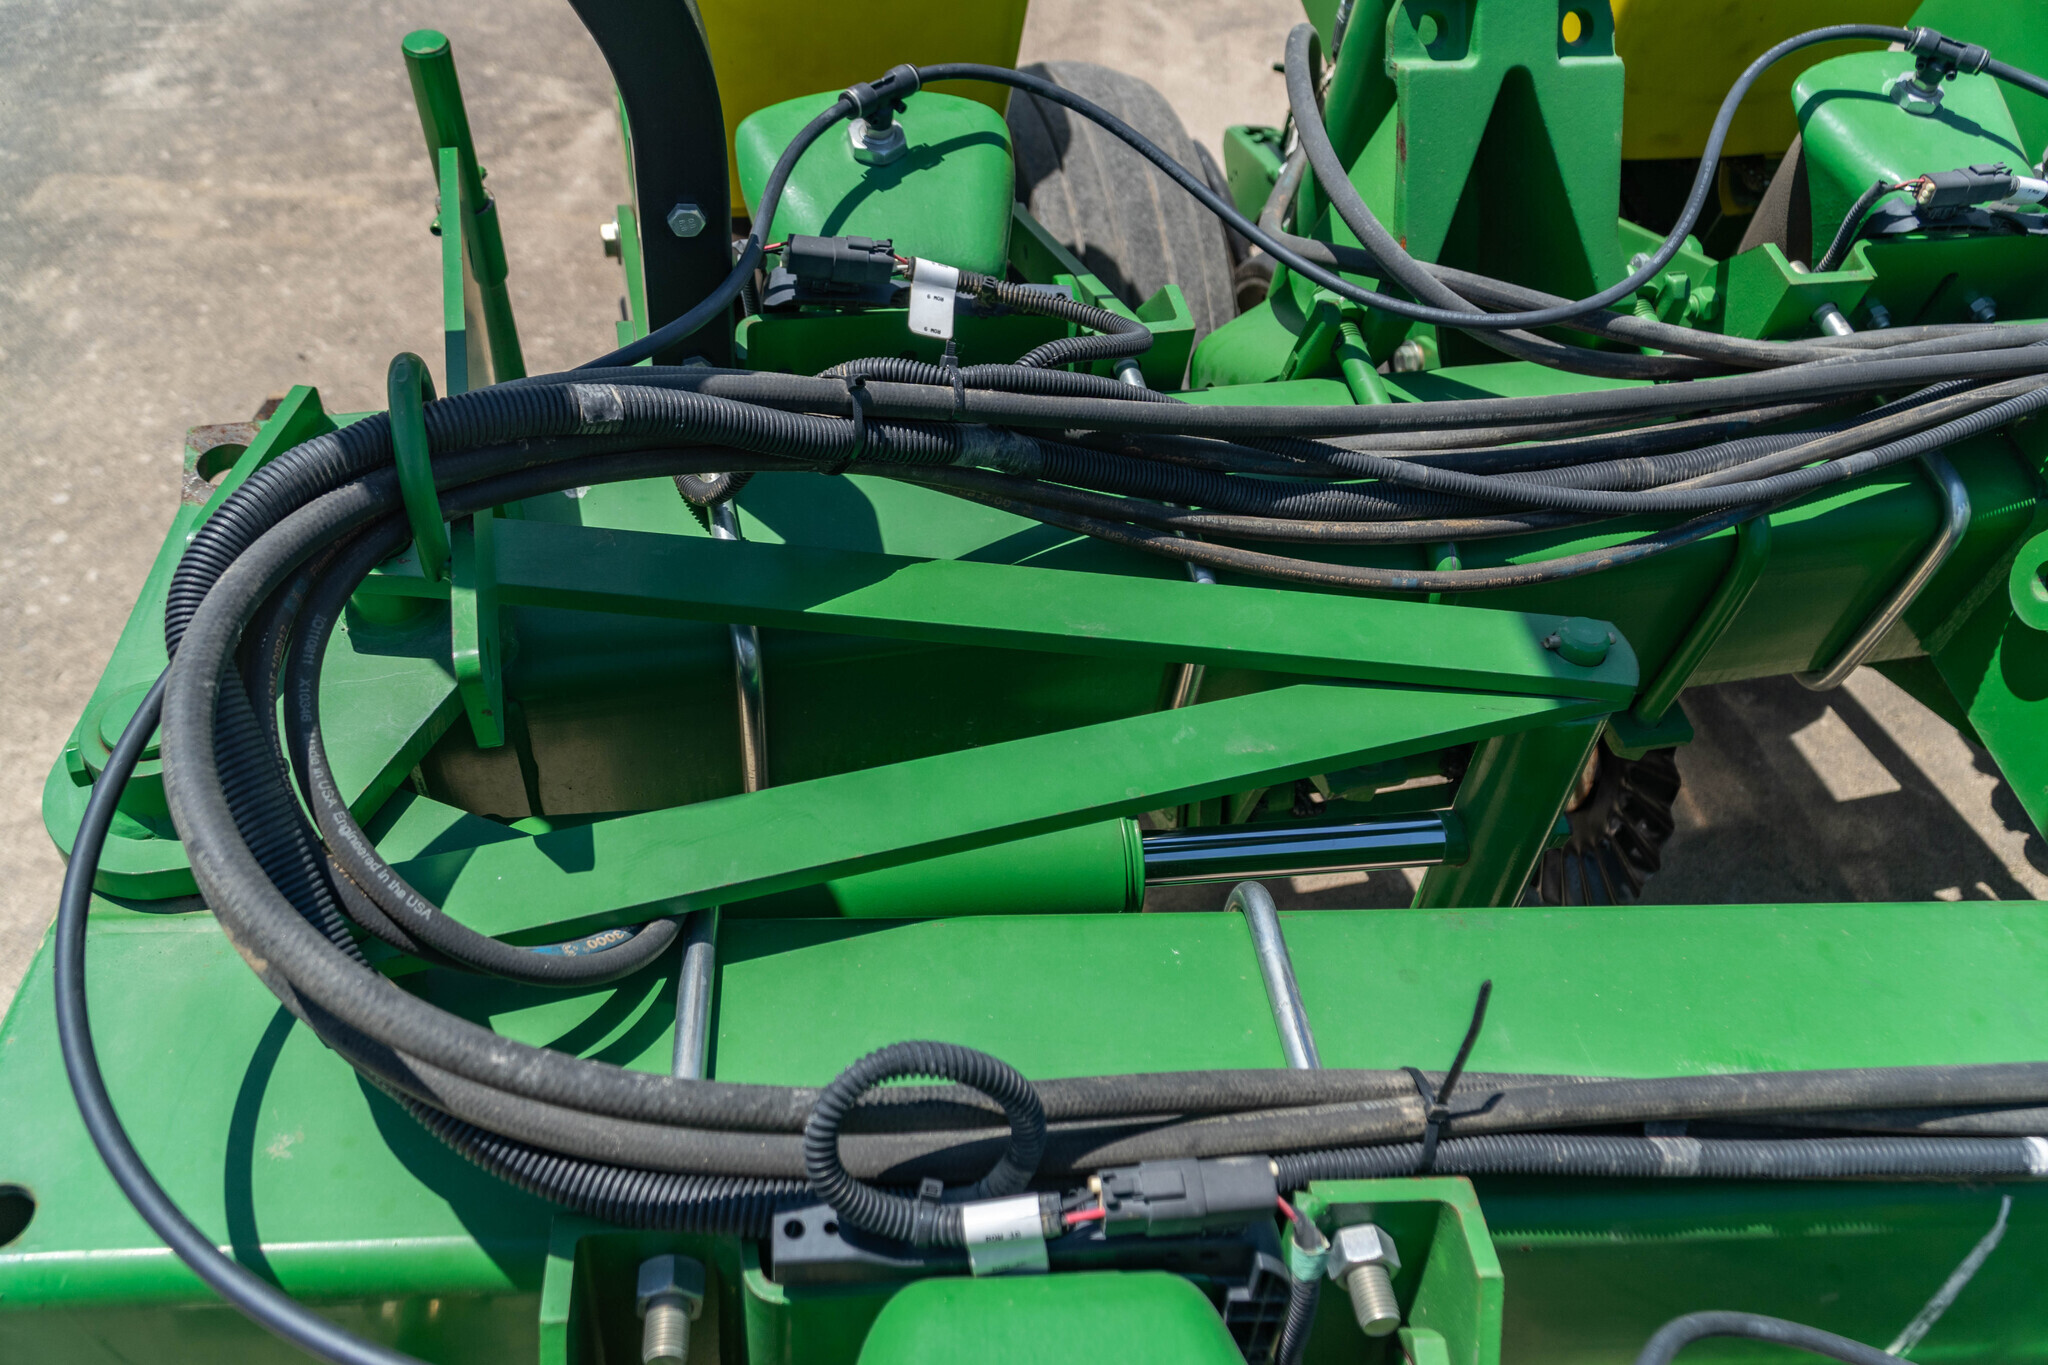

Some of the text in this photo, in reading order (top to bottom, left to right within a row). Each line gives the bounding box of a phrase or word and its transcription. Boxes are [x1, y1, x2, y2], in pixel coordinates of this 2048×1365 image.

[933, 294, 944, 302] ROW
[1187, 515, 1204, 523] USA
[1206, 515, 1219, 525] the
[1228, 518, 1272, 531] Engineered
[1276, 522, 1292, 531] USA
[1488, 576, 1511, 587] MSHA
[299, 678, 313, 722] X10346
[304, 732, 320, 765] Made
[313, 768, 324, 779] in
[317, 780, 338, 809] USA
[332, 811, 383, 873] Engineered
[377, 868, 390, 884] in
[387, 879, 407, 900] the
[405, 895, 432, 921] USA
[586, 929, 625, 949] 3000
